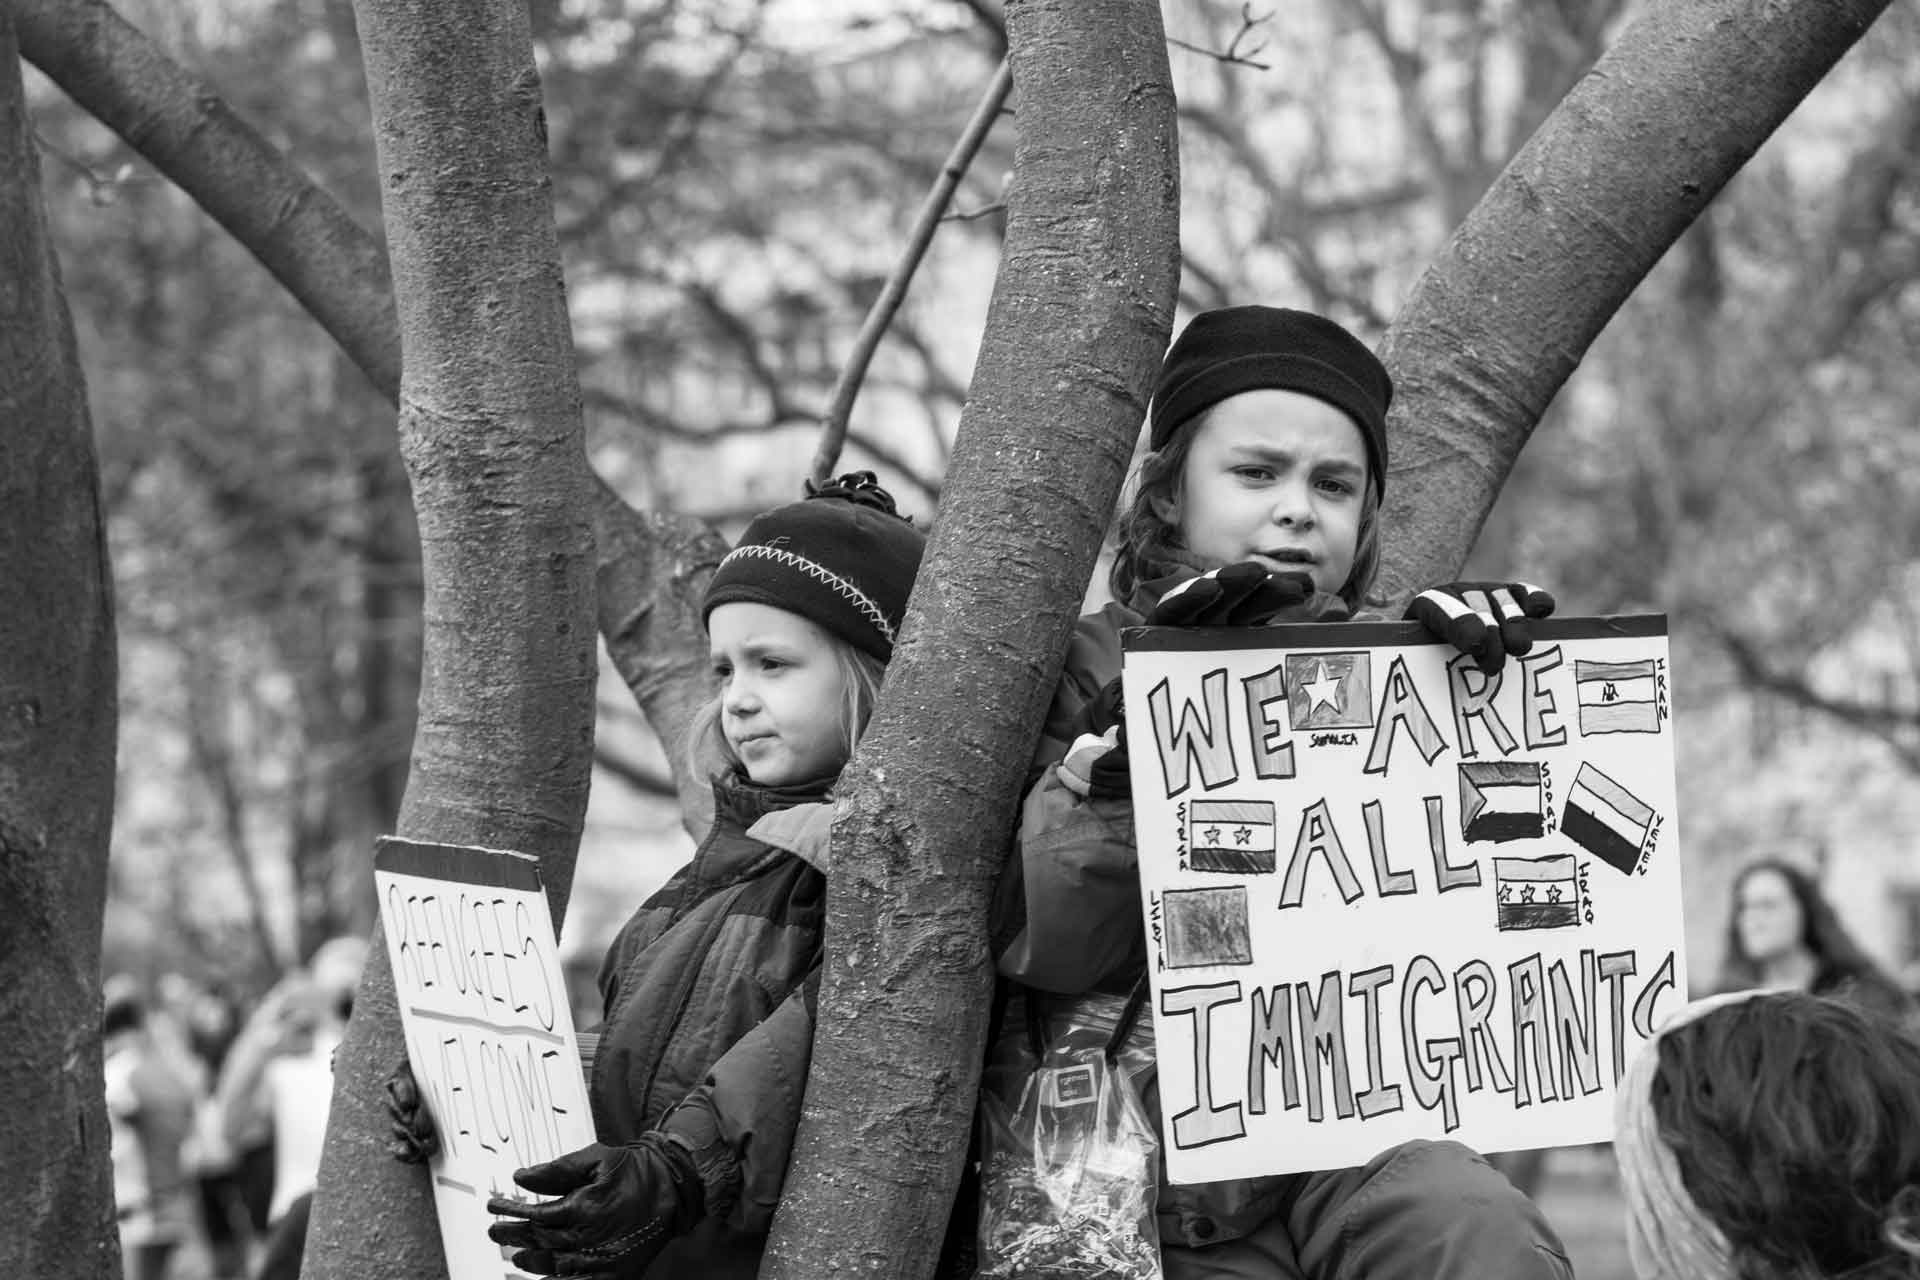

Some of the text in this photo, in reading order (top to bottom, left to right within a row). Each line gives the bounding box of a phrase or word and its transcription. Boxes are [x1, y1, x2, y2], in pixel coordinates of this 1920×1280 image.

[1147, 644, 1568, 799] WE ARE
[1656, 657, 1668, 721] IRAN
[1540, 760, 1557, 835] SUDAN
[1175, 801, 1189, 873] SYRIA
[1278, 795, 1482, 909] ALL
[1636, 814, 1665, 877] YEMEN
[1578, 861, 1595, 925] IRAQ
